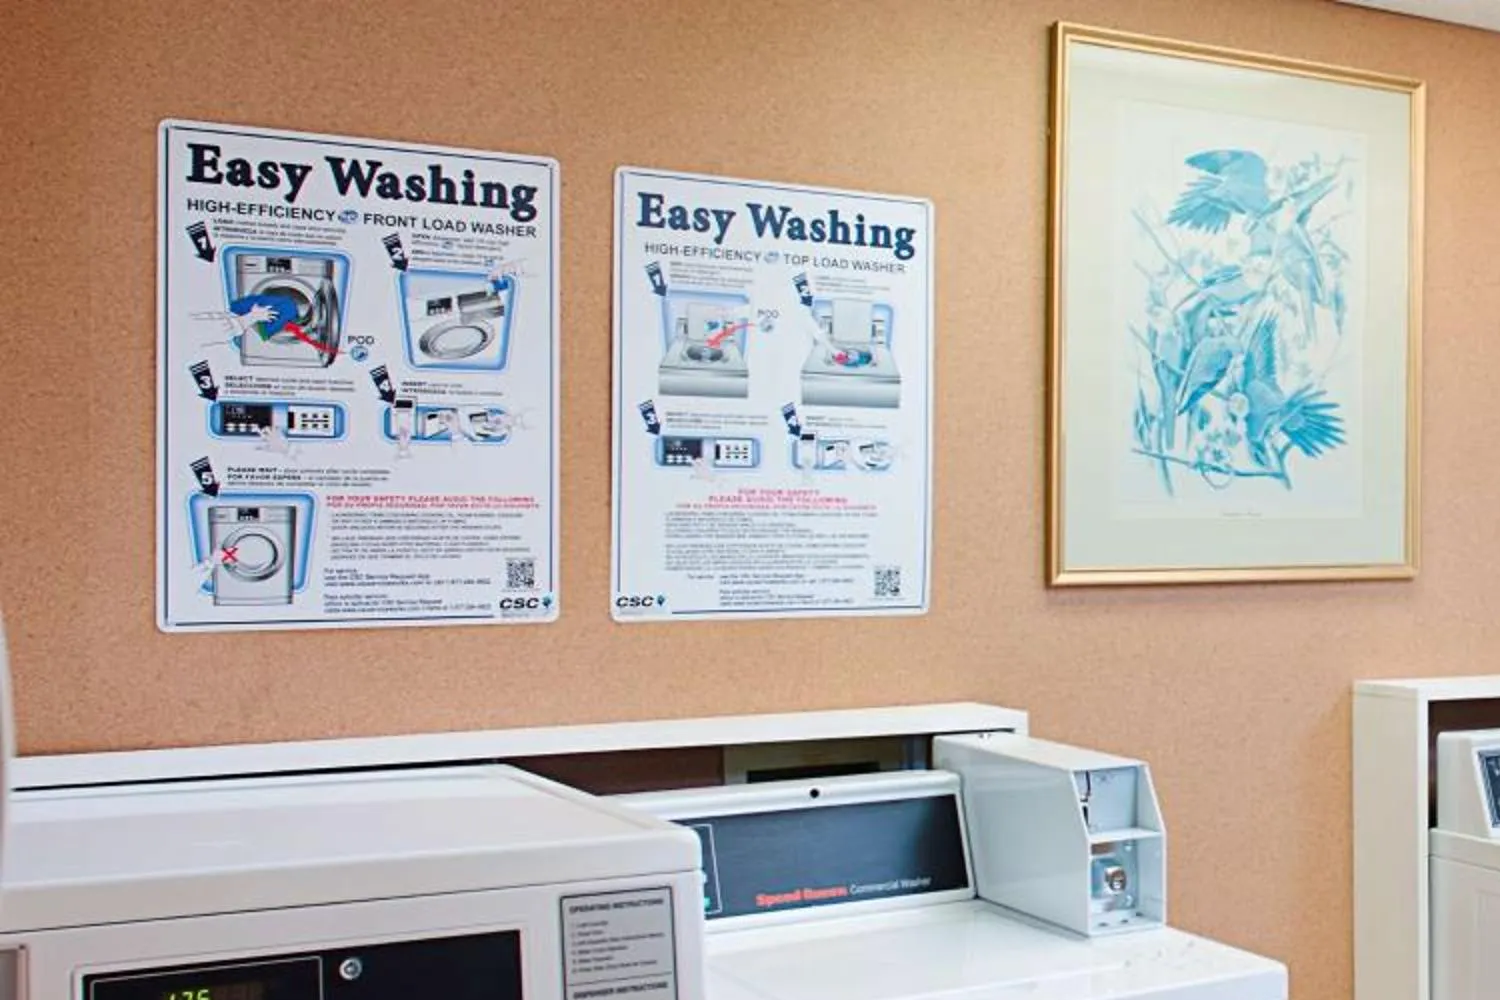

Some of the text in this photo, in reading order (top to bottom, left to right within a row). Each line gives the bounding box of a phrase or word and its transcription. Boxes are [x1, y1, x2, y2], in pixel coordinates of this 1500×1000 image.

[186, 143, 539, 223] Easy Washing
[187, 198, 537, 239] HIGH-EFFICIENCY FRONT LOAD WASHER
[636, 192, 917, 261] Easy Washing
[644, 243, 907, 274] HIGH-EFFICIENCY TOP LOAD WASHER
[499, 597, 539, 609] CSC
[616, 595, 654, 607] CSC
[755, 888, 801, 909] Speed
[803, 885, 848, 900] Queen
[850, 880, 898, 896] Commercial
